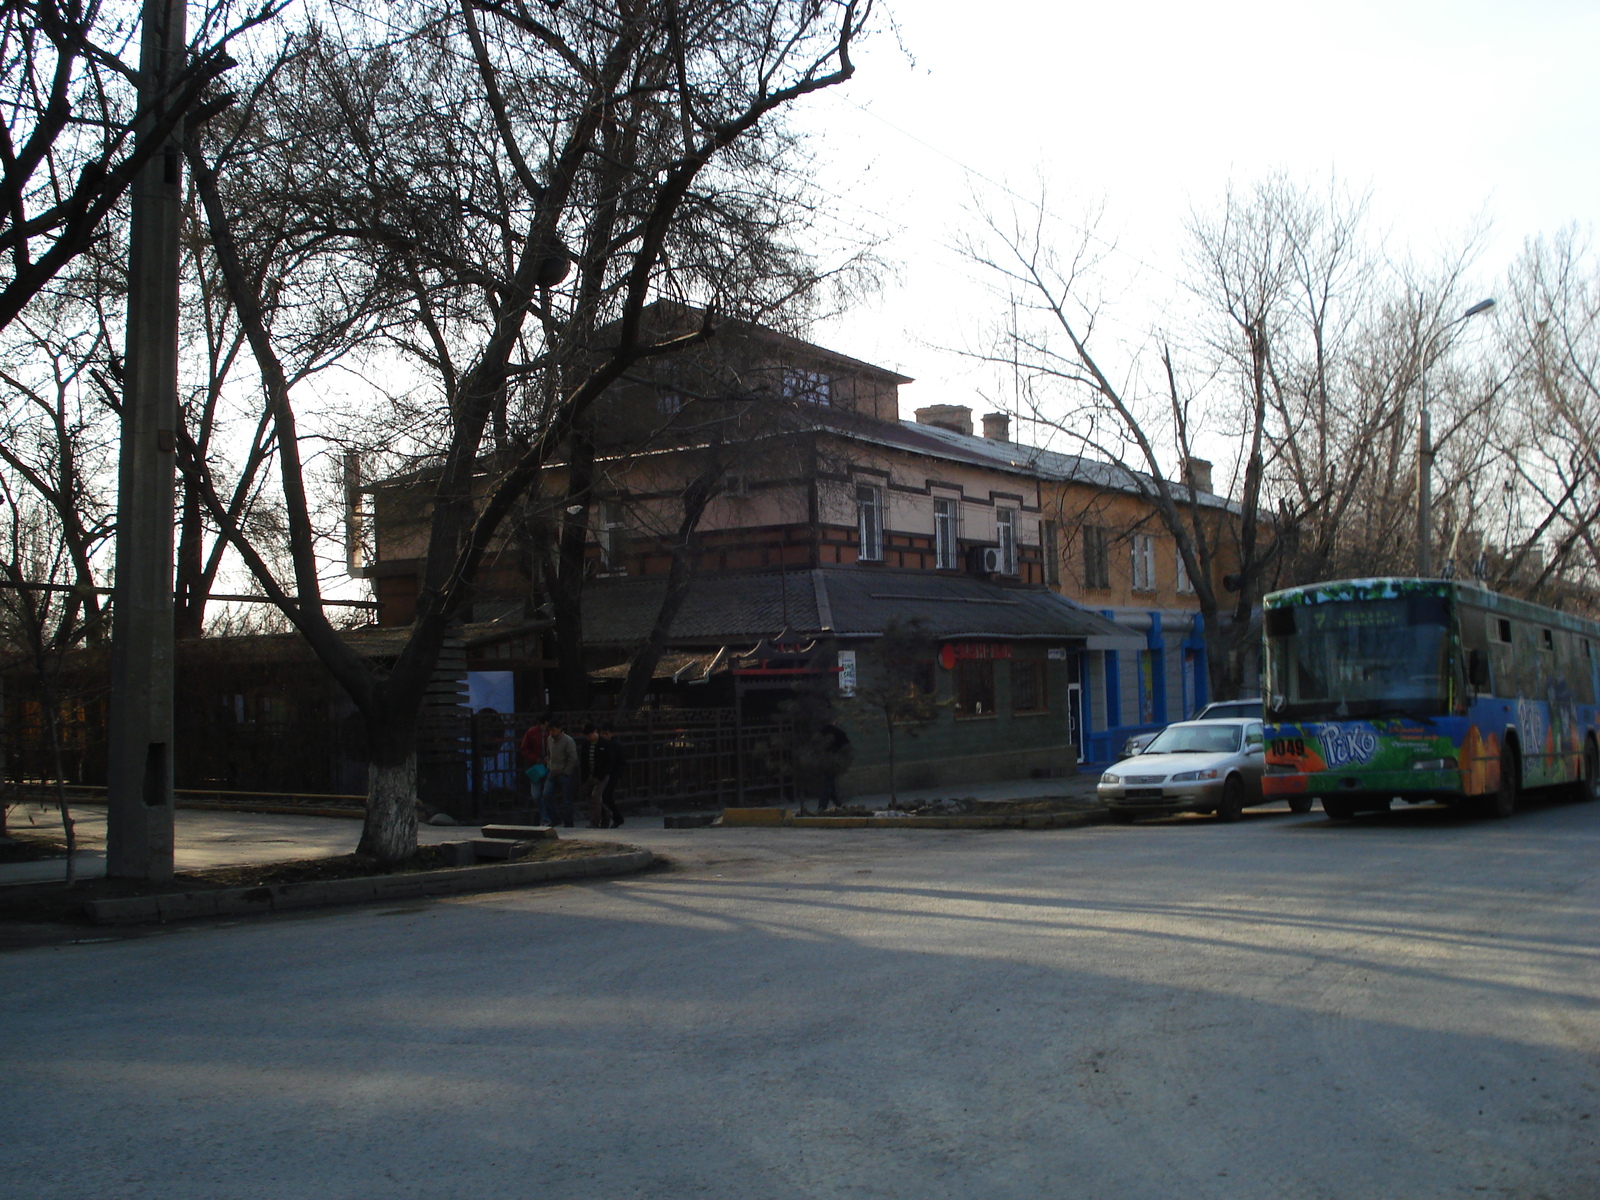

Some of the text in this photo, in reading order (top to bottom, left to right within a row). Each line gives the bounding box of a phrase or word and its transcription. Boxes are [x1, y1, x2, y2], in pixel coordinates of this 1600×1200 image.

[1314, 612, 1326, 629] 7
[1273, 695, 1284, 713] 7
[1270, 739, 1304, 756] 1049
